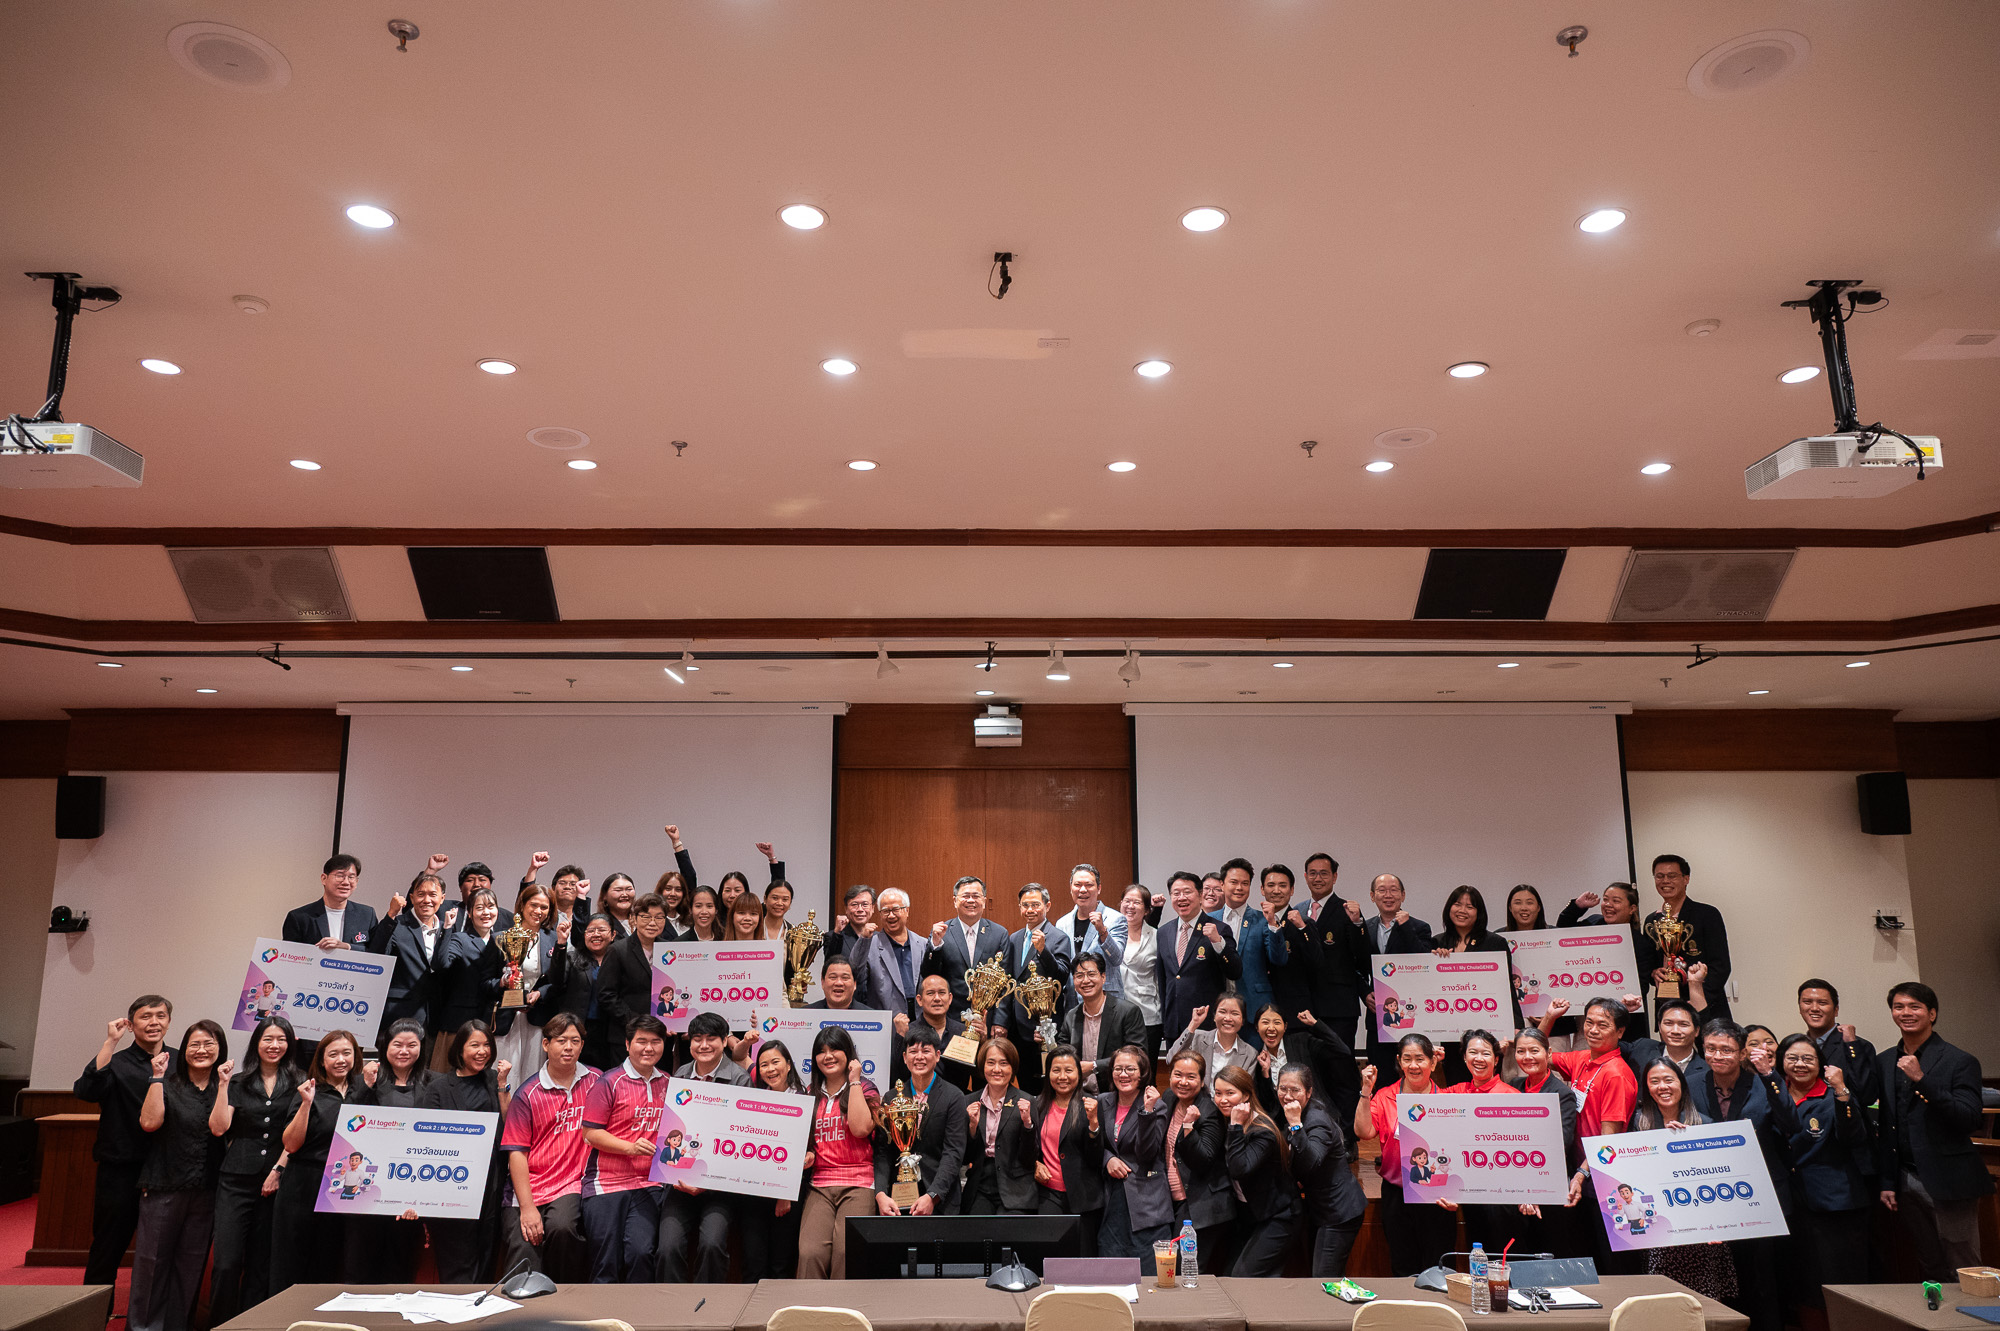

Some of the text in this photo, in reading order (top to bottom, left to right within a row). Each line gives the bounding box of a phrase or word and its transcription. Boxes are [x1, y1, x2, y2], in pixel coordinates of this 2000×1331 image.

[288, 953, 313, 962] together
[1565, 956, 1594, 966] รางวัลที่
[718, 971, 745, 980] รางวัลที่
[1548, 970, 1623, 988] 20,000
[318, 981, 348, 991] รางวัลที่
[1441, 982, 1470, 991] รางวัลที่
[700, 987, 769, 1004] 50,000
[292, 992, 369, 1016] 20,000
[1424, 998, 1498, 1014] 30,000
[702, 1095, 729, 1103] together
[1436, 1107, 1466, 1115] together
[377, 1120, 406, 1128] together
[554, 1116, 583, 1135] chul
[631, 1117, 660, 1131] chul
[815, 1115, 844, 1130] eam
[729, 1125, 779, 1137] รางวัลชมเชย
[814, 1127, 846, 1143] chula
[1474, 1132, 1530, 1141] รางวัลชมเชย
[1723, 1138, 1740, 1146] Agent
[406, 1147, 460, 1156] รางวัลชมเชย
[713, 1138, 788, 1164] 10,000
[1627, 1145, 1657, 1154] together
[1462, 1150, 1546, 1170] 10,000
[388, 1163, 469, 1183] 10,000
[1672, 1165, 1731, 1177] รางวัลชมเชย
[1662, 1181, 1754, 1207] 10,000
